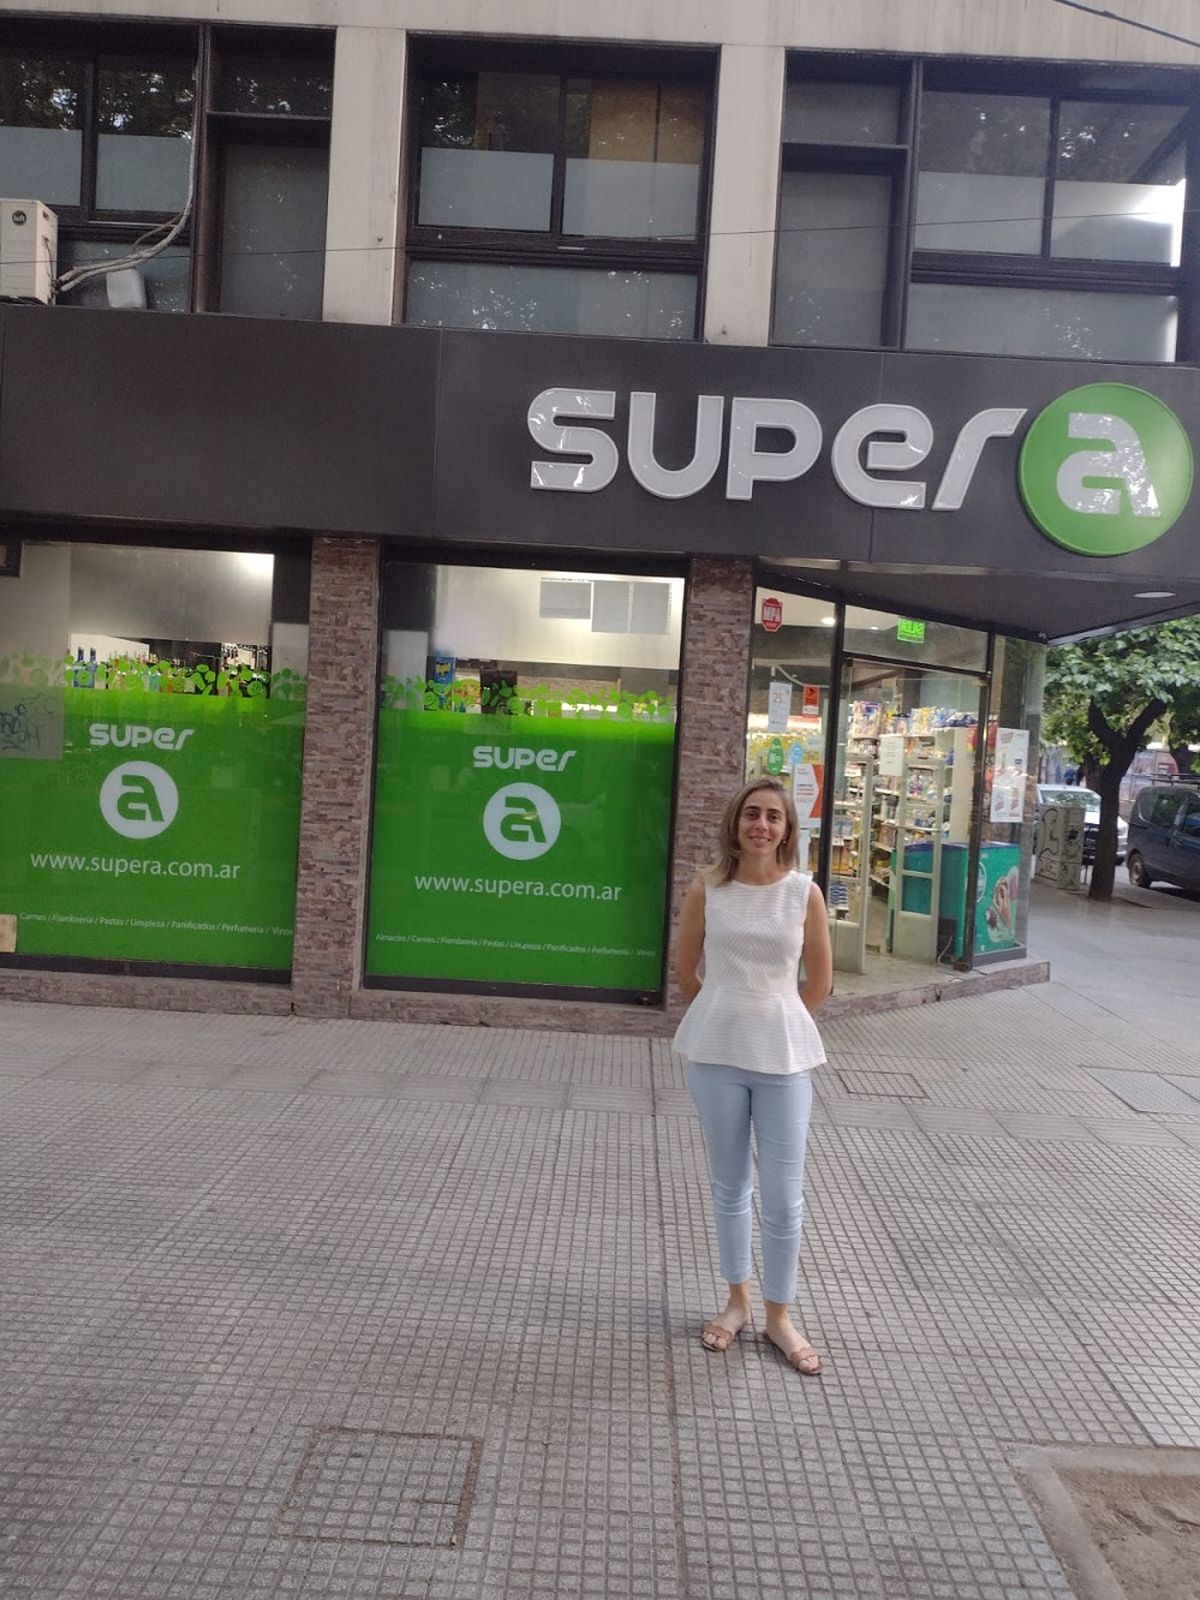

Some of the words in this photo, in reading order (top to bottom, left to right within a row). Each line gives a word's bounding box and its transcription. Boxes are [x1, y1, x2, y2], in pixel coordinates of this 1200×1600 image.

[30, 853, 240, 879] www.supera.com.ar
[414, 875, 622, 901] www.supera.com.ar
[100, 916, 124, 926] Pastas
[130, 918, 165, 929] Limpieza
[172, 920, 216, 931] Panificados
[547, 943, 585, 953] Panificados
